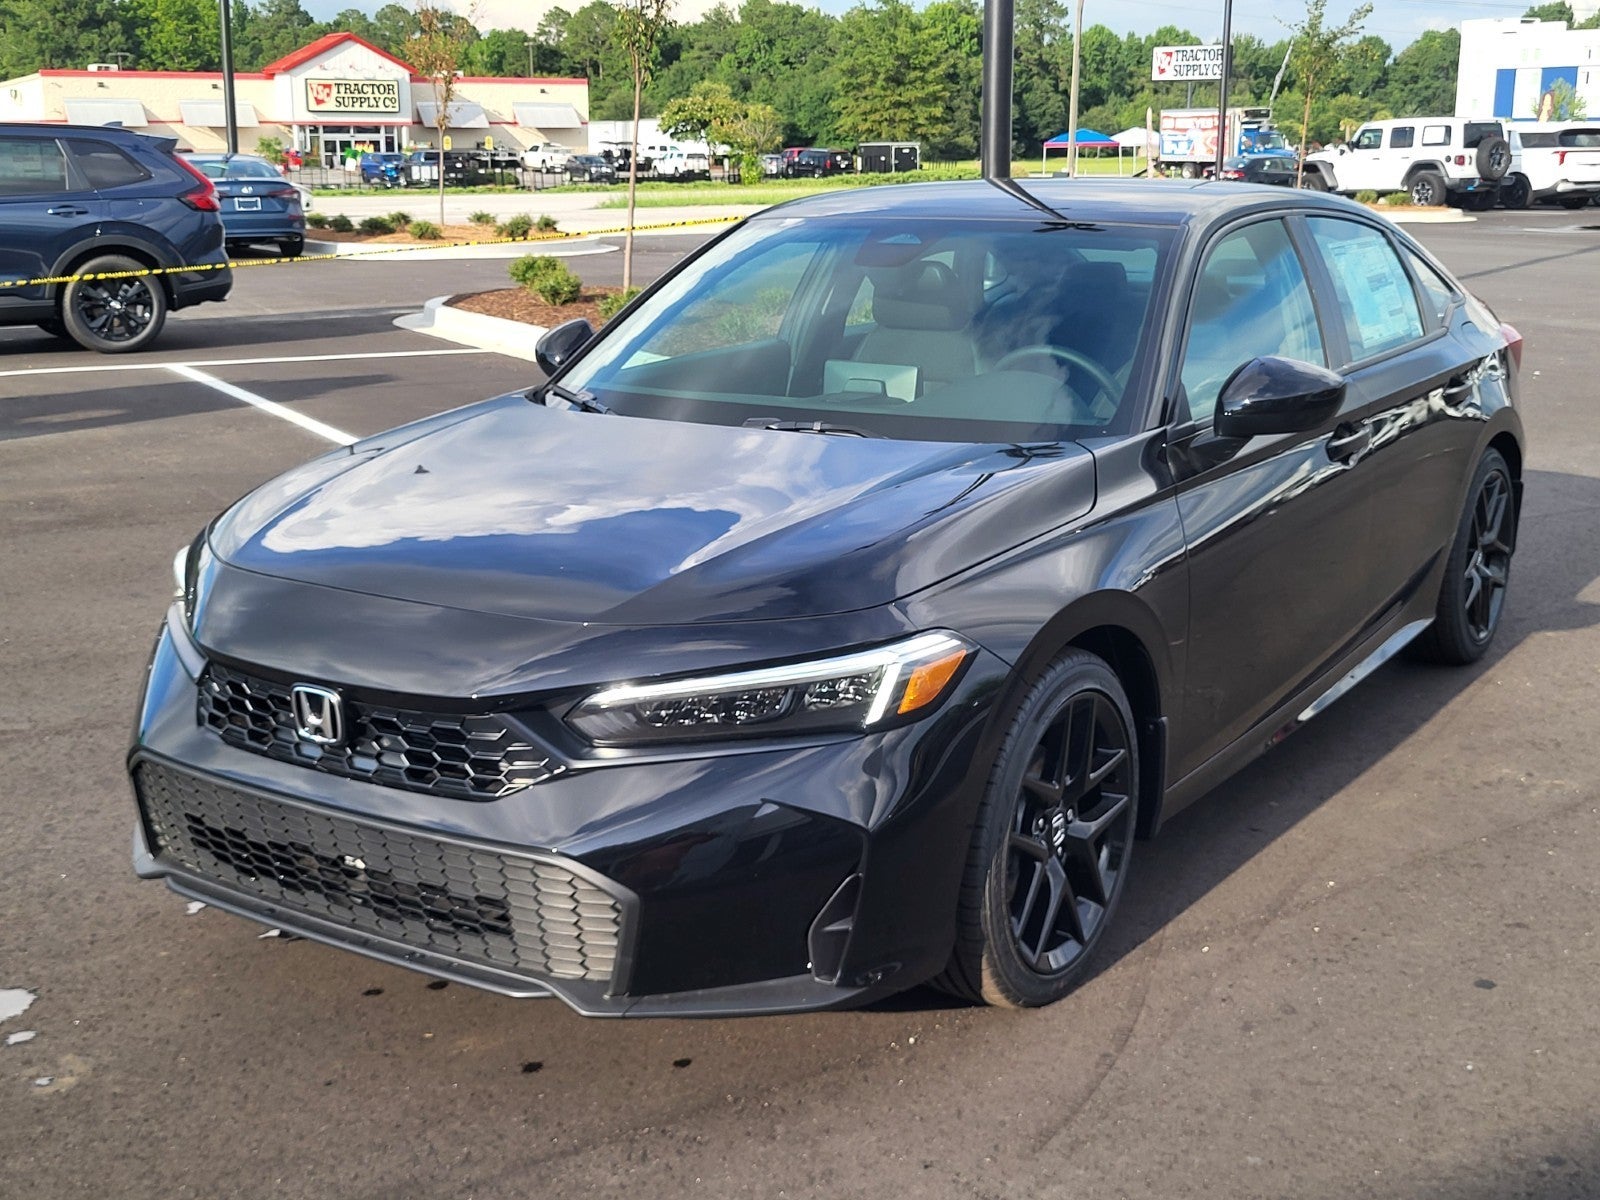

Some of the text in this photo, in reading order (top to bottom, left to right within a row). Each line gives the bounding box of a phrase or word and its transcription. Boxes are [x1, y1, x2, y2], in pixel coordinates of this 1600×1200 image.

[1174, 48, 1224, 62] TRACTOR
[1173, 64, 1211, 77] SUPPLY
[334, 83, 396, 95] TRACTOR
[335, 96, 381, 108] SUPPLY
